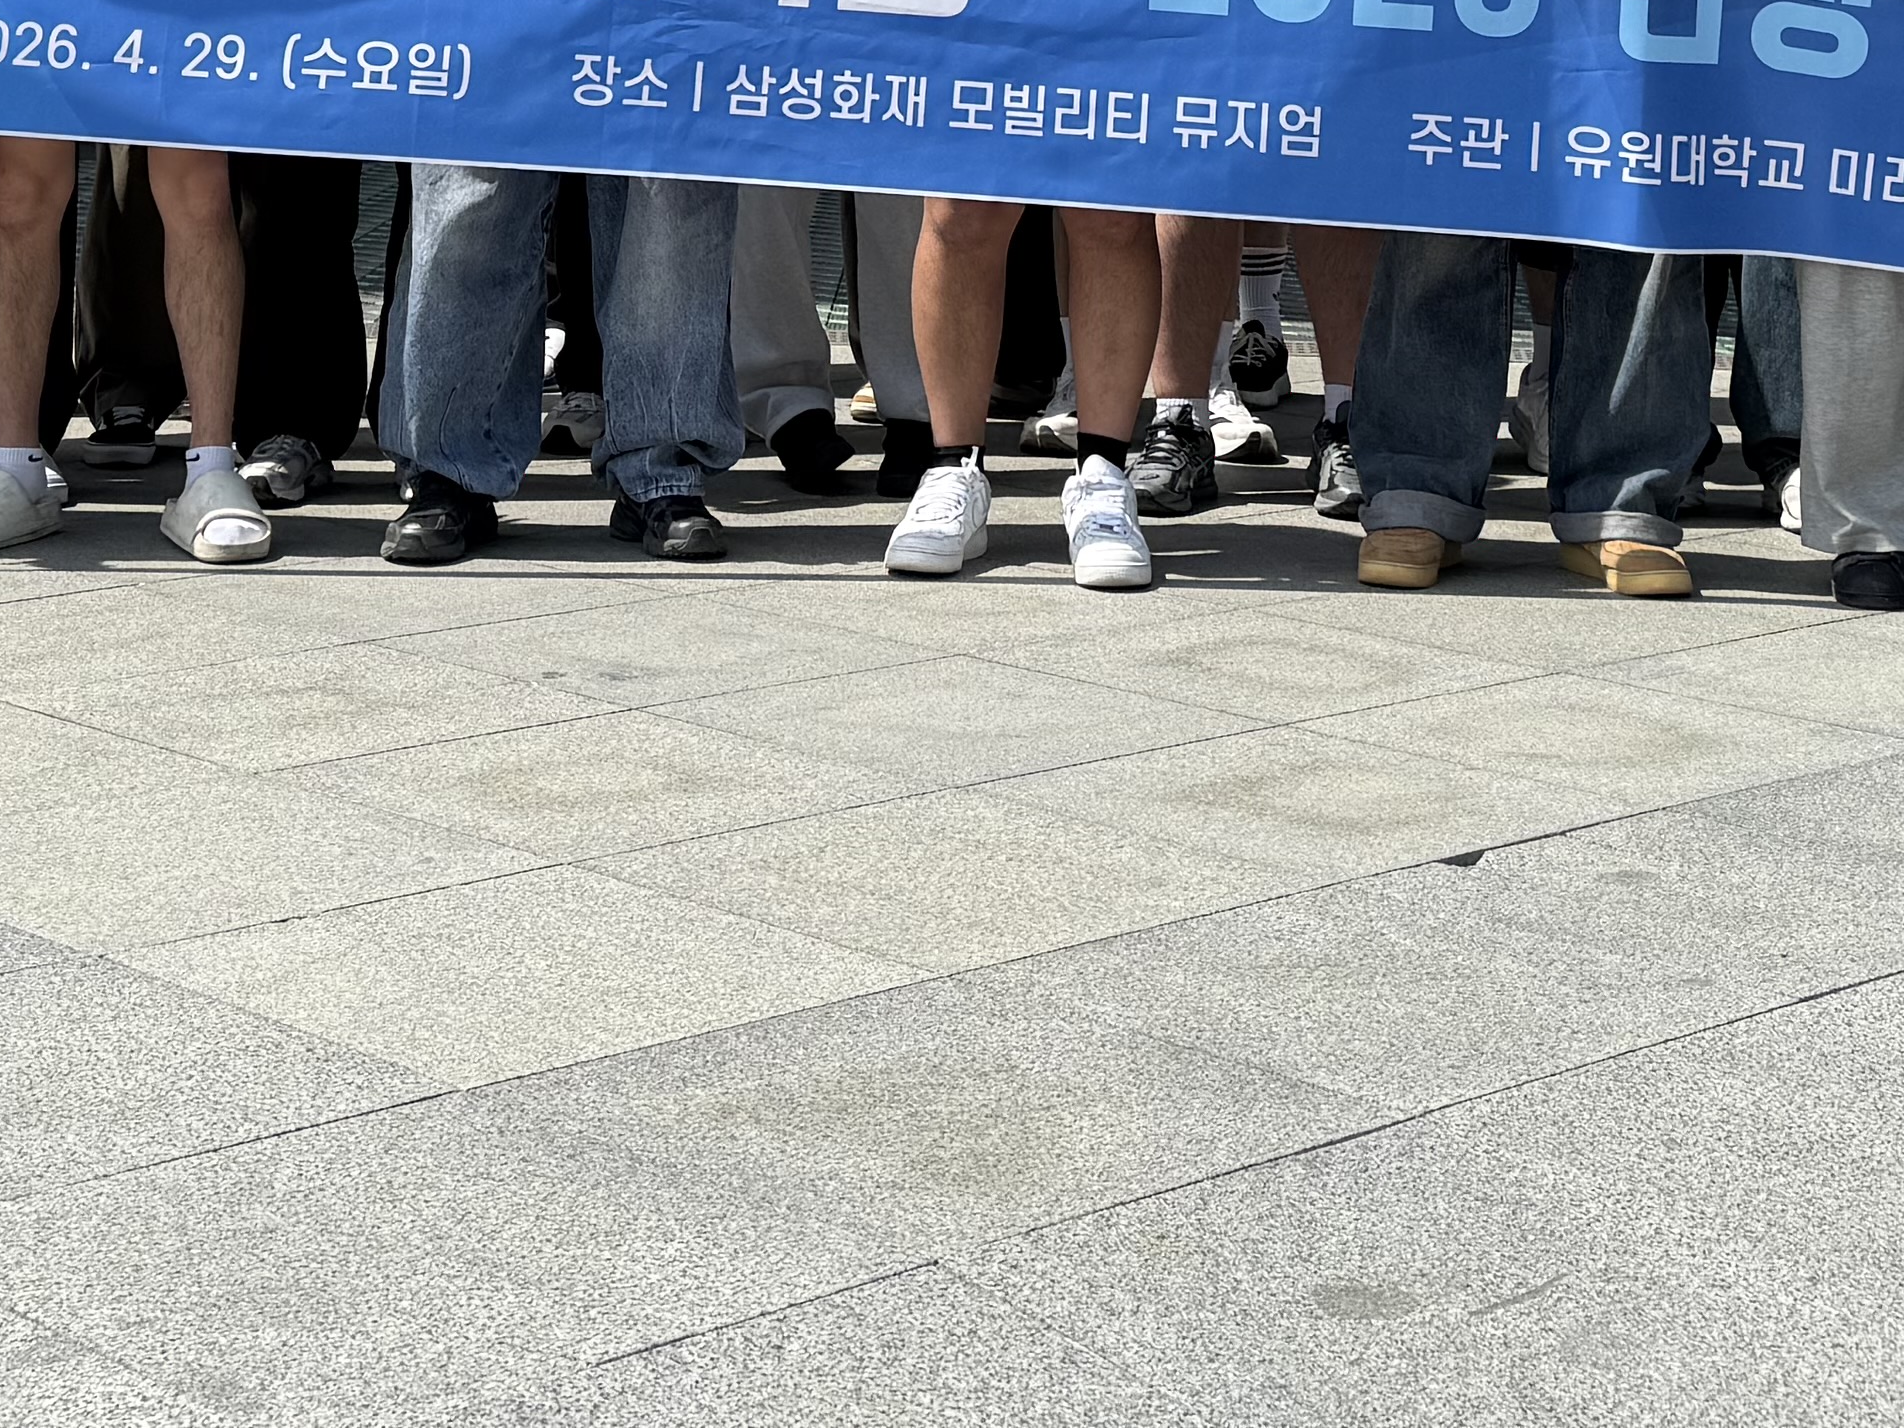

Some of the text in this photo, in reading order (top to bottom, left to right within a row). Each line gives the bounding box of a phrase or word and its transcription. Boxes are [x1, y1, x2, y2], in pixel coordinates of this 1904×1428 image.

[113, 29, 159, 76] 4.
[181, 32, 259, 81] 29.
[282, 32, 472, 101] (수요일)
[572, 53, 669, 109] 장소
[726, 64, 928, 129] 삼성화재
[948, 79, 1151, 145] 모빌리티
[1172, 96, 1323, 158] 뮤지엄
[1407, 112, 1510, 171] 주관
[1564, 125, 1806, 194] 유원대학교
